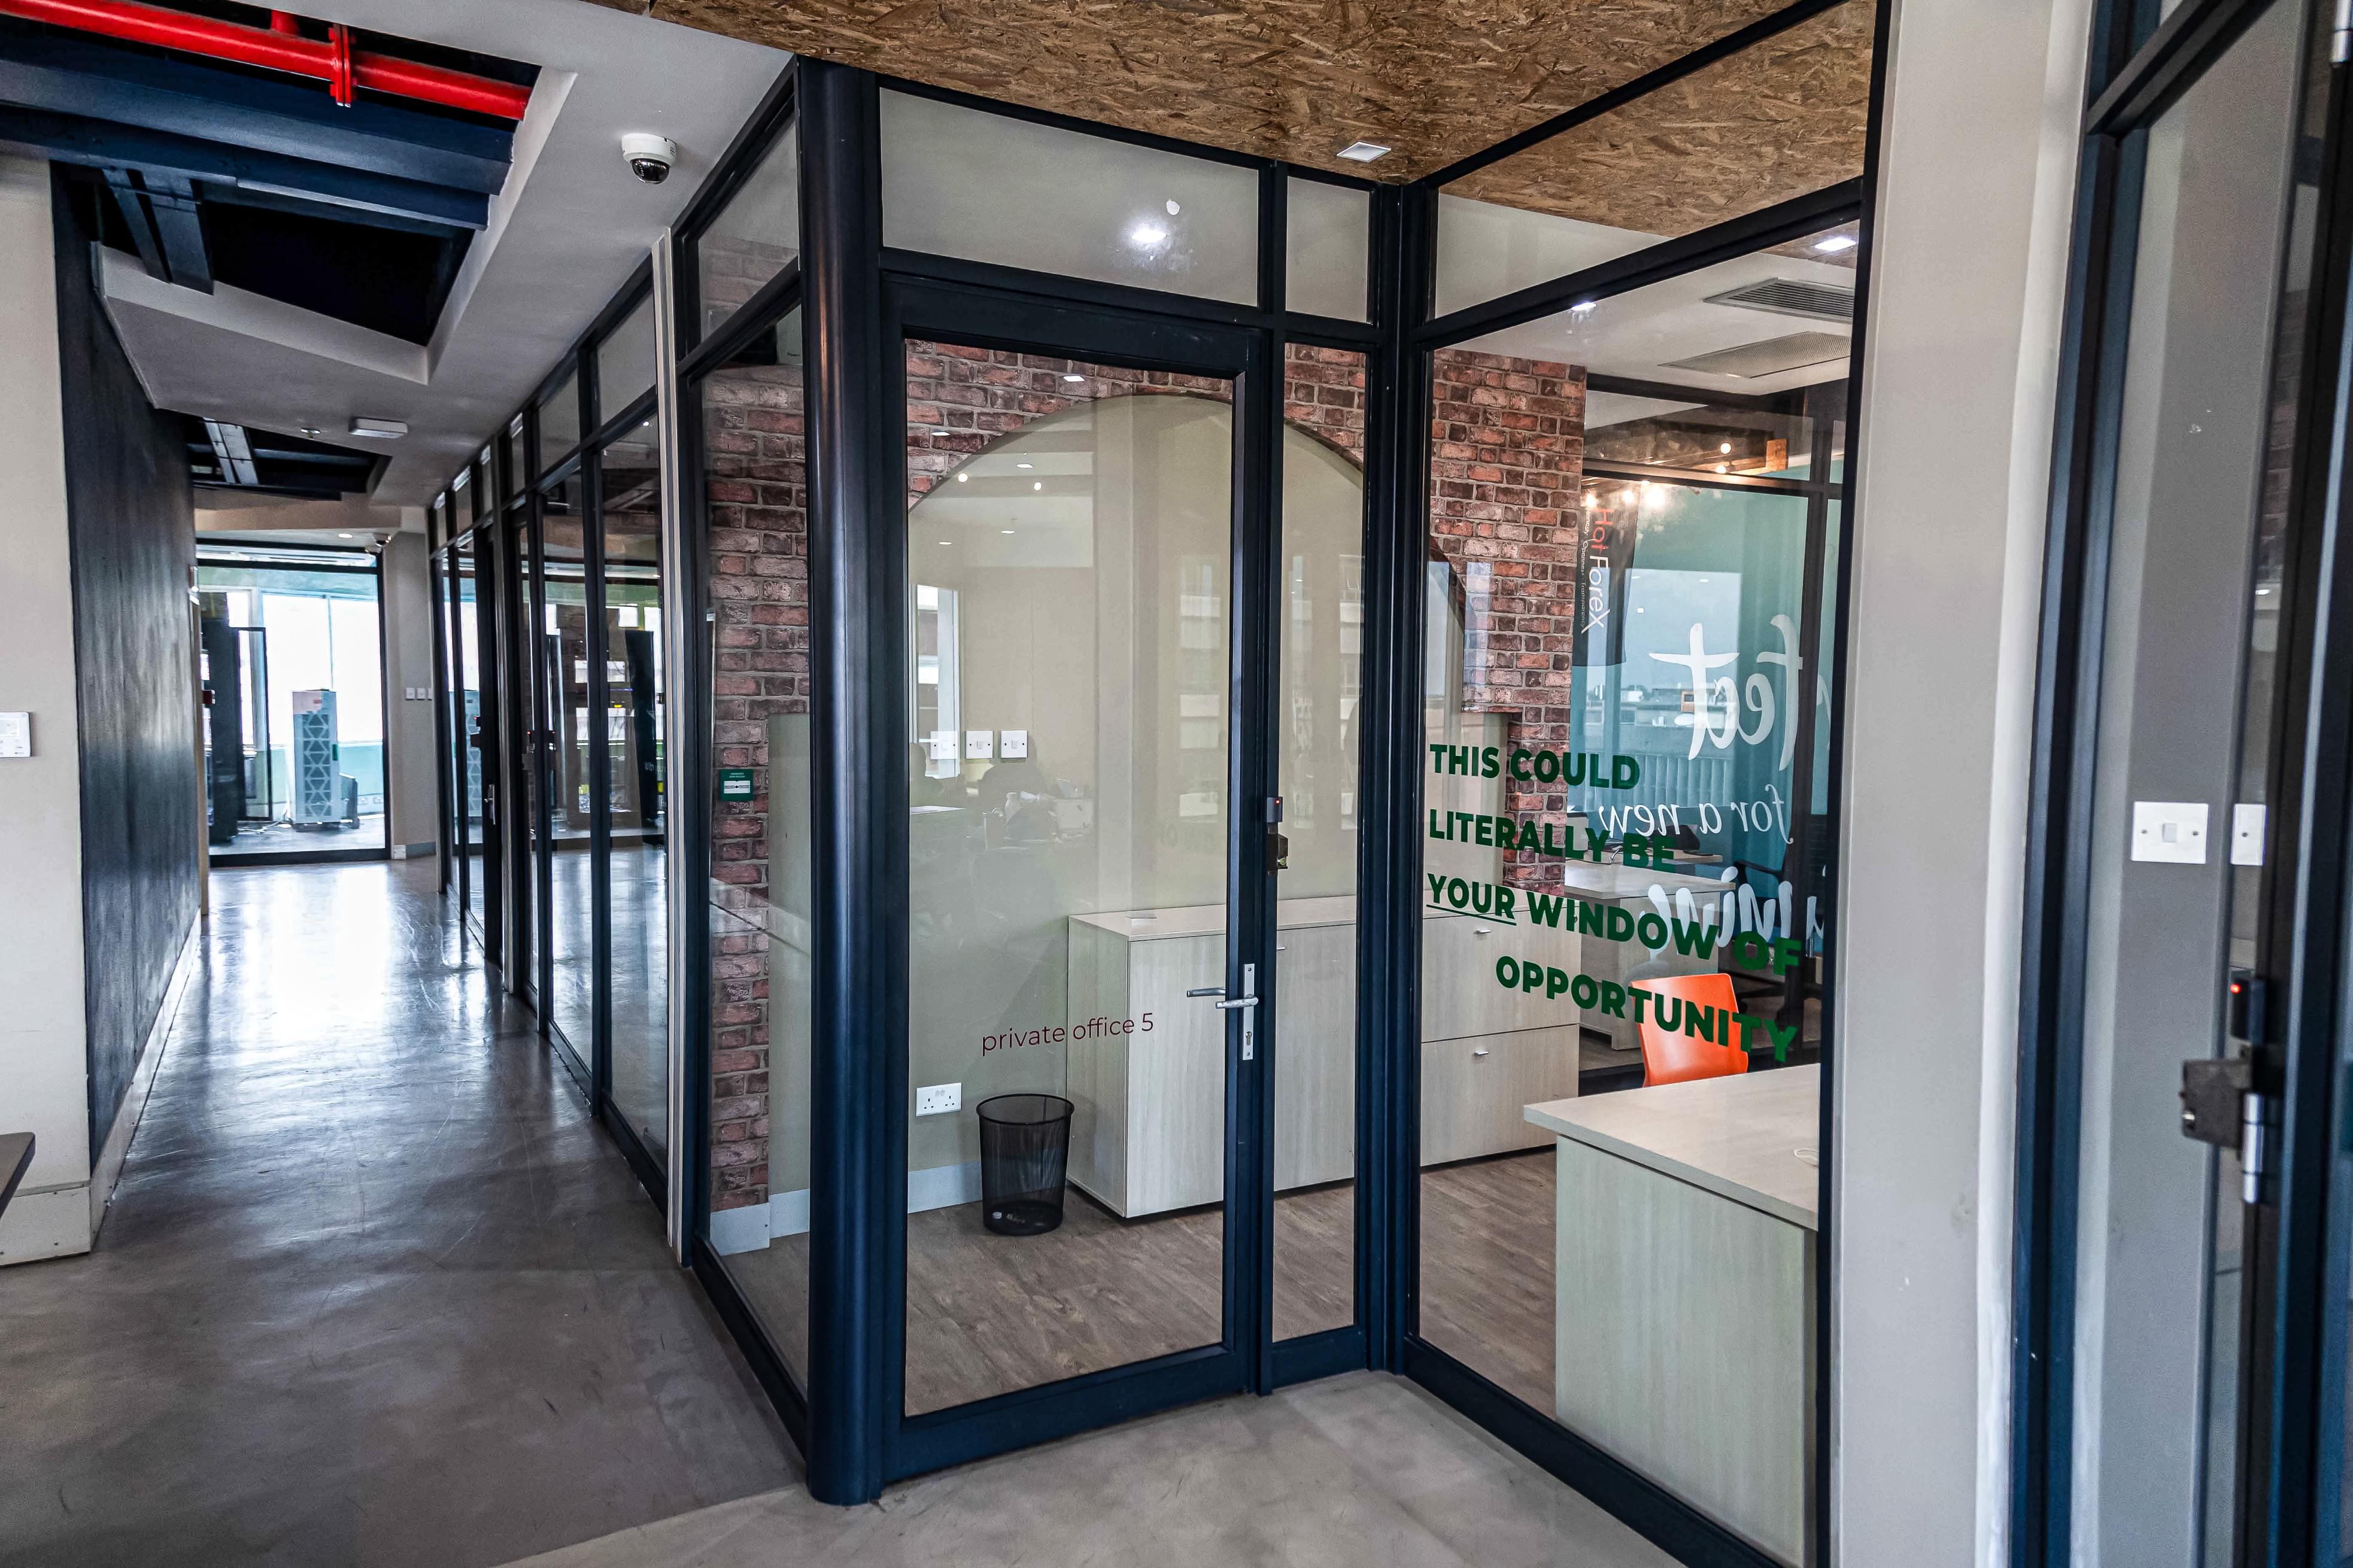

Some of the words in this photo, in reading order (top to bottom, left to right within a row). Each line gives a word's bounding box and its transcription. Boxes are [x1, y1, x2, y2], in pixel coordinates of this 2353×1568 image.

[1429, 744, 1500, 778] THIS
[1510, 749, 1640, 789] COULD
[1429, 809, 1611, 863] LITERALLY
[1623, 832, 1676, 873] BE
[1427, 873, 1516, 919] YOUR
[1526, 891, 1719, 960] WINDOW
[1732, 930, 1802, 976] OF
[982, 1028, 1065, 1057] private
[1073, 1017, 1134, 1040] office
[1141, 1012, 1153, 1031] 5
[1496, 955, 1798, 1063] OPPORTUNITY
